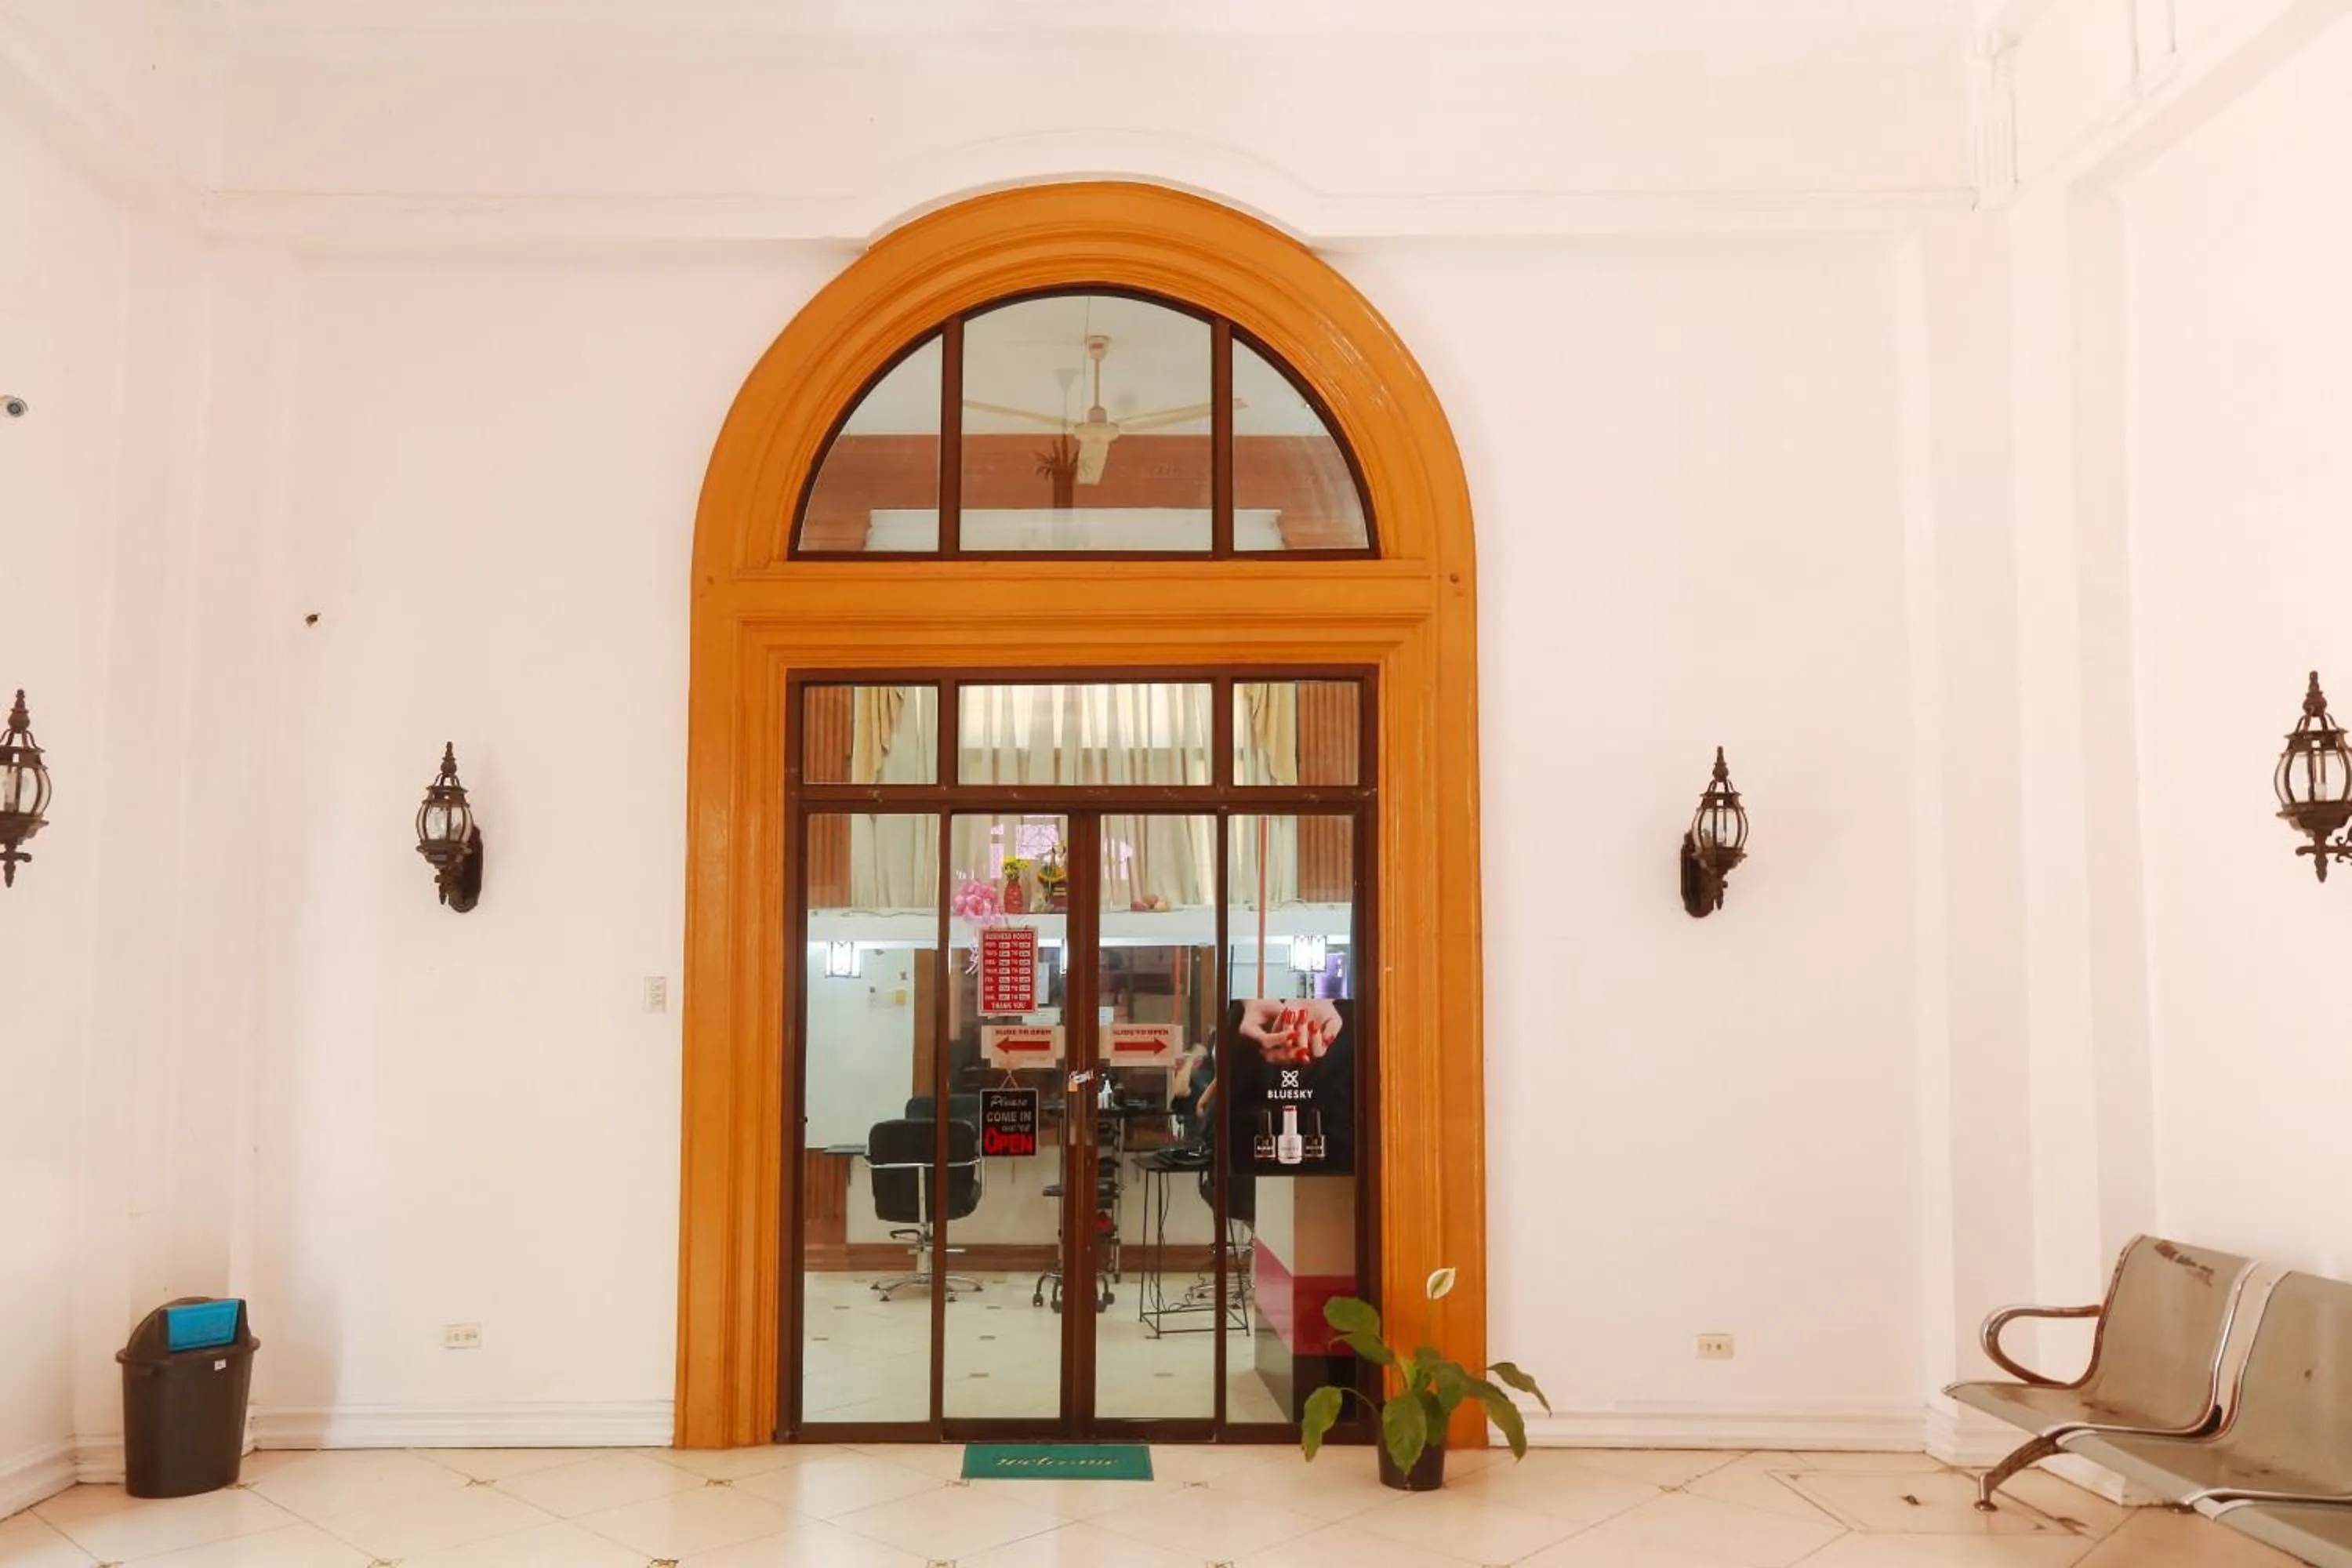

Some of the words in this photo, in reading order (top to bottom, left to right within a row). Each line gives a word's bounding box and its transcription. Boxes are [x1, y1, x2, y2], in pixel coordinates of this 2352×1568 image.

[1267, 1089, 1314, 1099] BLUESKY
[990, 1095, 1029, 1108] Please
[986, 1111, 1017, 1122] COME
[1020, 1110, 1032, 1122] IN
[985, 1127, 1033, 1153] OPEN
